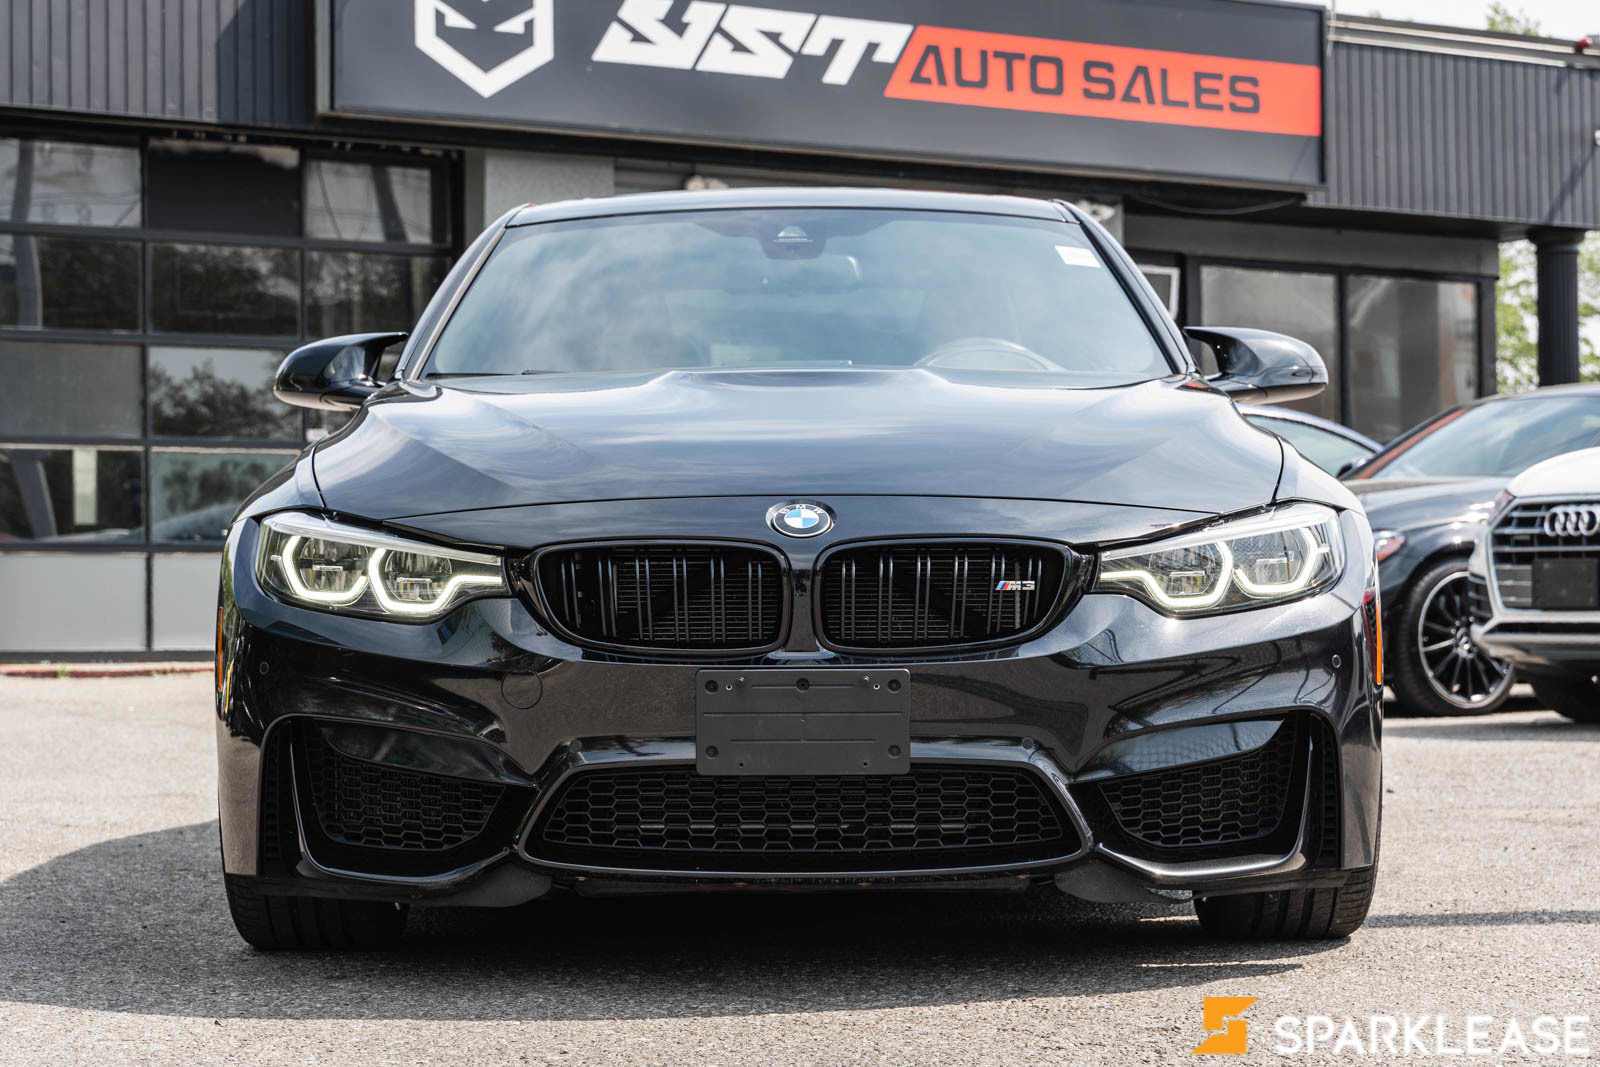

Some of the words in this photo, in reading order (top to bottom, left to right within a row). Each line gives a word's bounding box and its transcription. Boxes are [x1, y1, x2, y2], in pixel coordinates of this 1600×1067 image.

[909, 44, 1065, 96] AUTO
[1082, 59, 1261, 114] SALES
[995, 580, 1036, 591] M3
